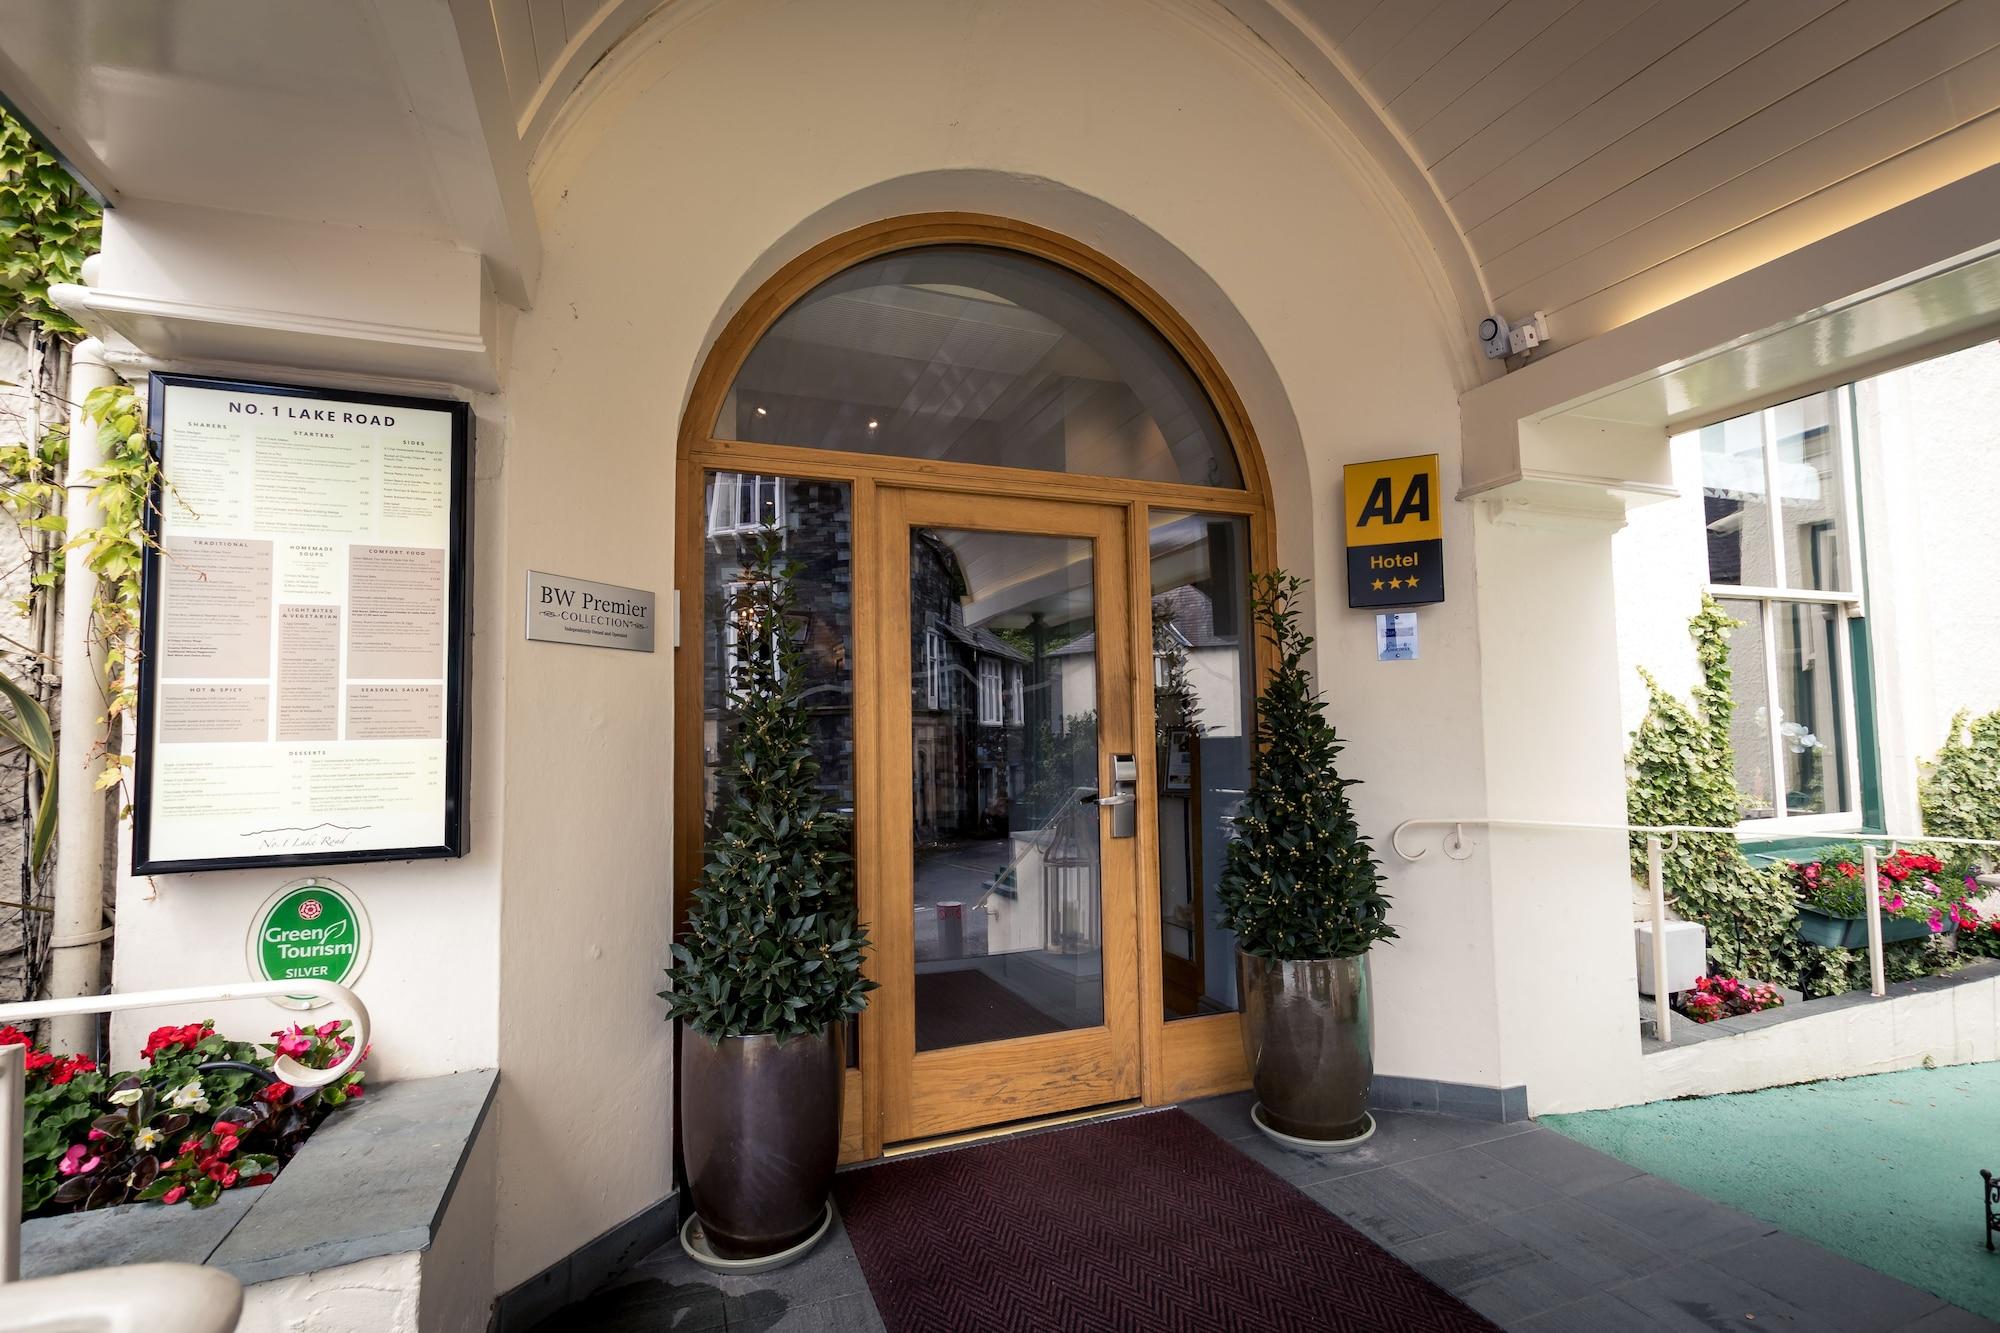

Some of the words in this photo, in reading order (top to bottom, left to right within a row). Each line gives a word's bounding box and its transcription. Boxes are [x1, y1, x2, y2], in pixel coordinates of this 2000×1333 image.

[229, 402, 264, 415] NO.
[272, 406, 279, 417] 1
[289, 407, 336, 422] LAKE
[343, 412, 395, 427] ROAD
[188, 421, 228, 430] SHARERS
[293, 430, 334, 439] STARTERS
[1355, 473, 1430, 527] AA
[193, 540, 248, 548] TRADITIONAL
[1370, 552, 1419, 570] Hotel
[540, 585, 575, 607] BW
[582, 592, 647, 618] Premier
[561, 610, 629, 628] COLLECTION
[292, 834, 317, 847] Lake
[320, 831, 352, 847] Road
[265, 927, 323, 943] Green
[277, 943, 353, 959] Tourism
[285, 965, 329, 978] SILVER
